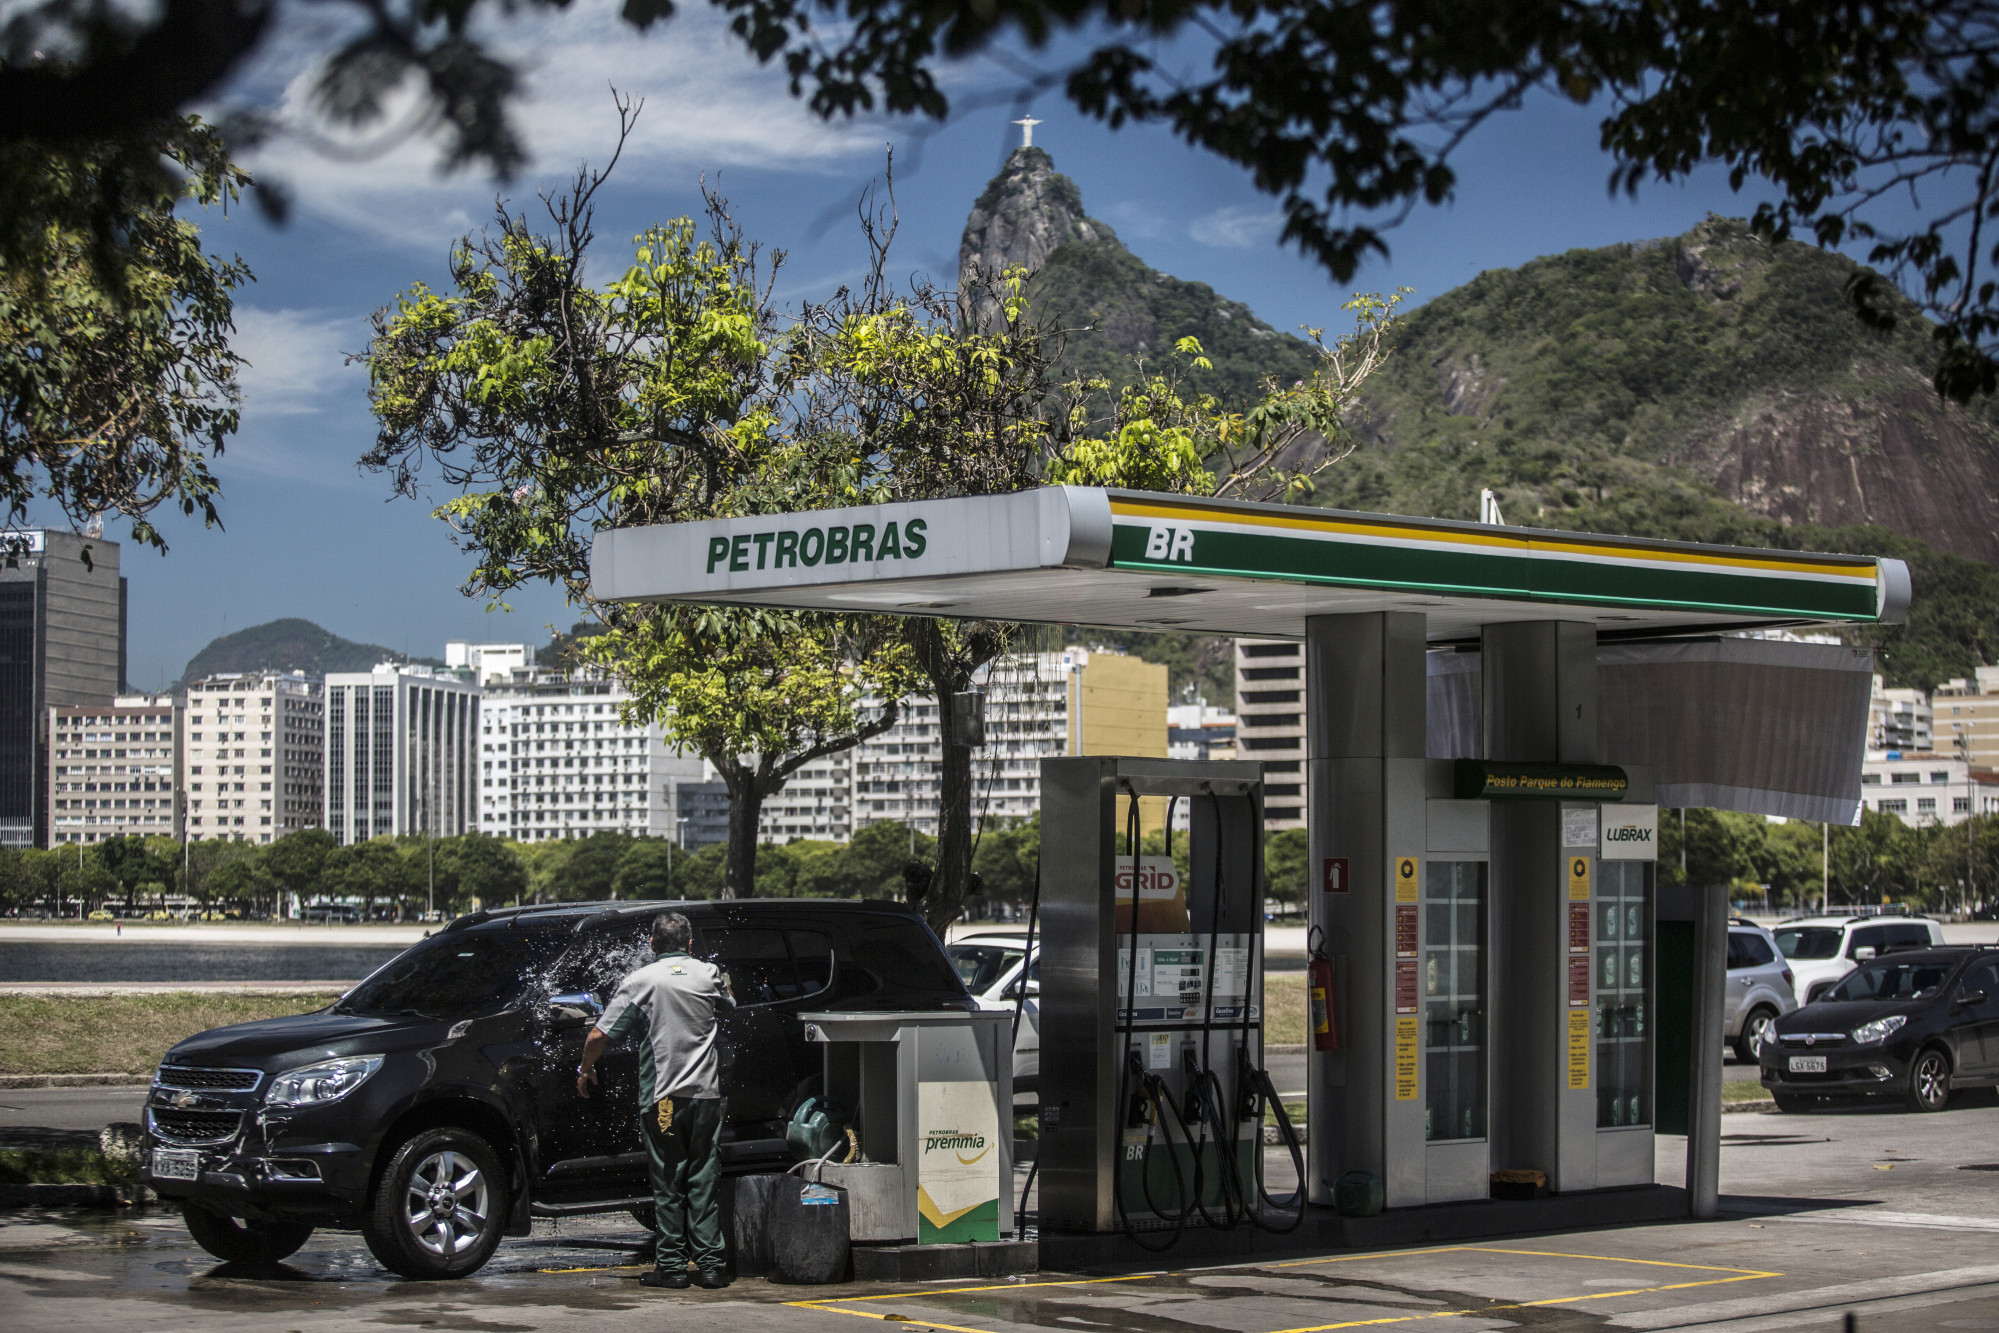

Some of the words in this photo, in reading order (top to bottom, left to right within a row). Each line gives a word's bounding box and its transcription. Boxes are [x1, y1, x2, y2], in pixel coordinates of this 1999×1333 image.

[707, 518, 927, 574] PETROBRAS
[1145, 526, 1195, 562] BR
[1576, 703, 1583, 720] 1
[1486, 774, 1517, 787] Posto
[1519, 775, 1558, 790] Parque
[1560, 776, 1573, 787] do
[1576, 776, 1626, 791] Flamengo
[1607, 828, 1652, 841] LUBRAX
[1115, 872, 1174, 889] GRID
[925, 1133, 985, 1155] premmia
[1126, 1145, 1144, 1160] BR
